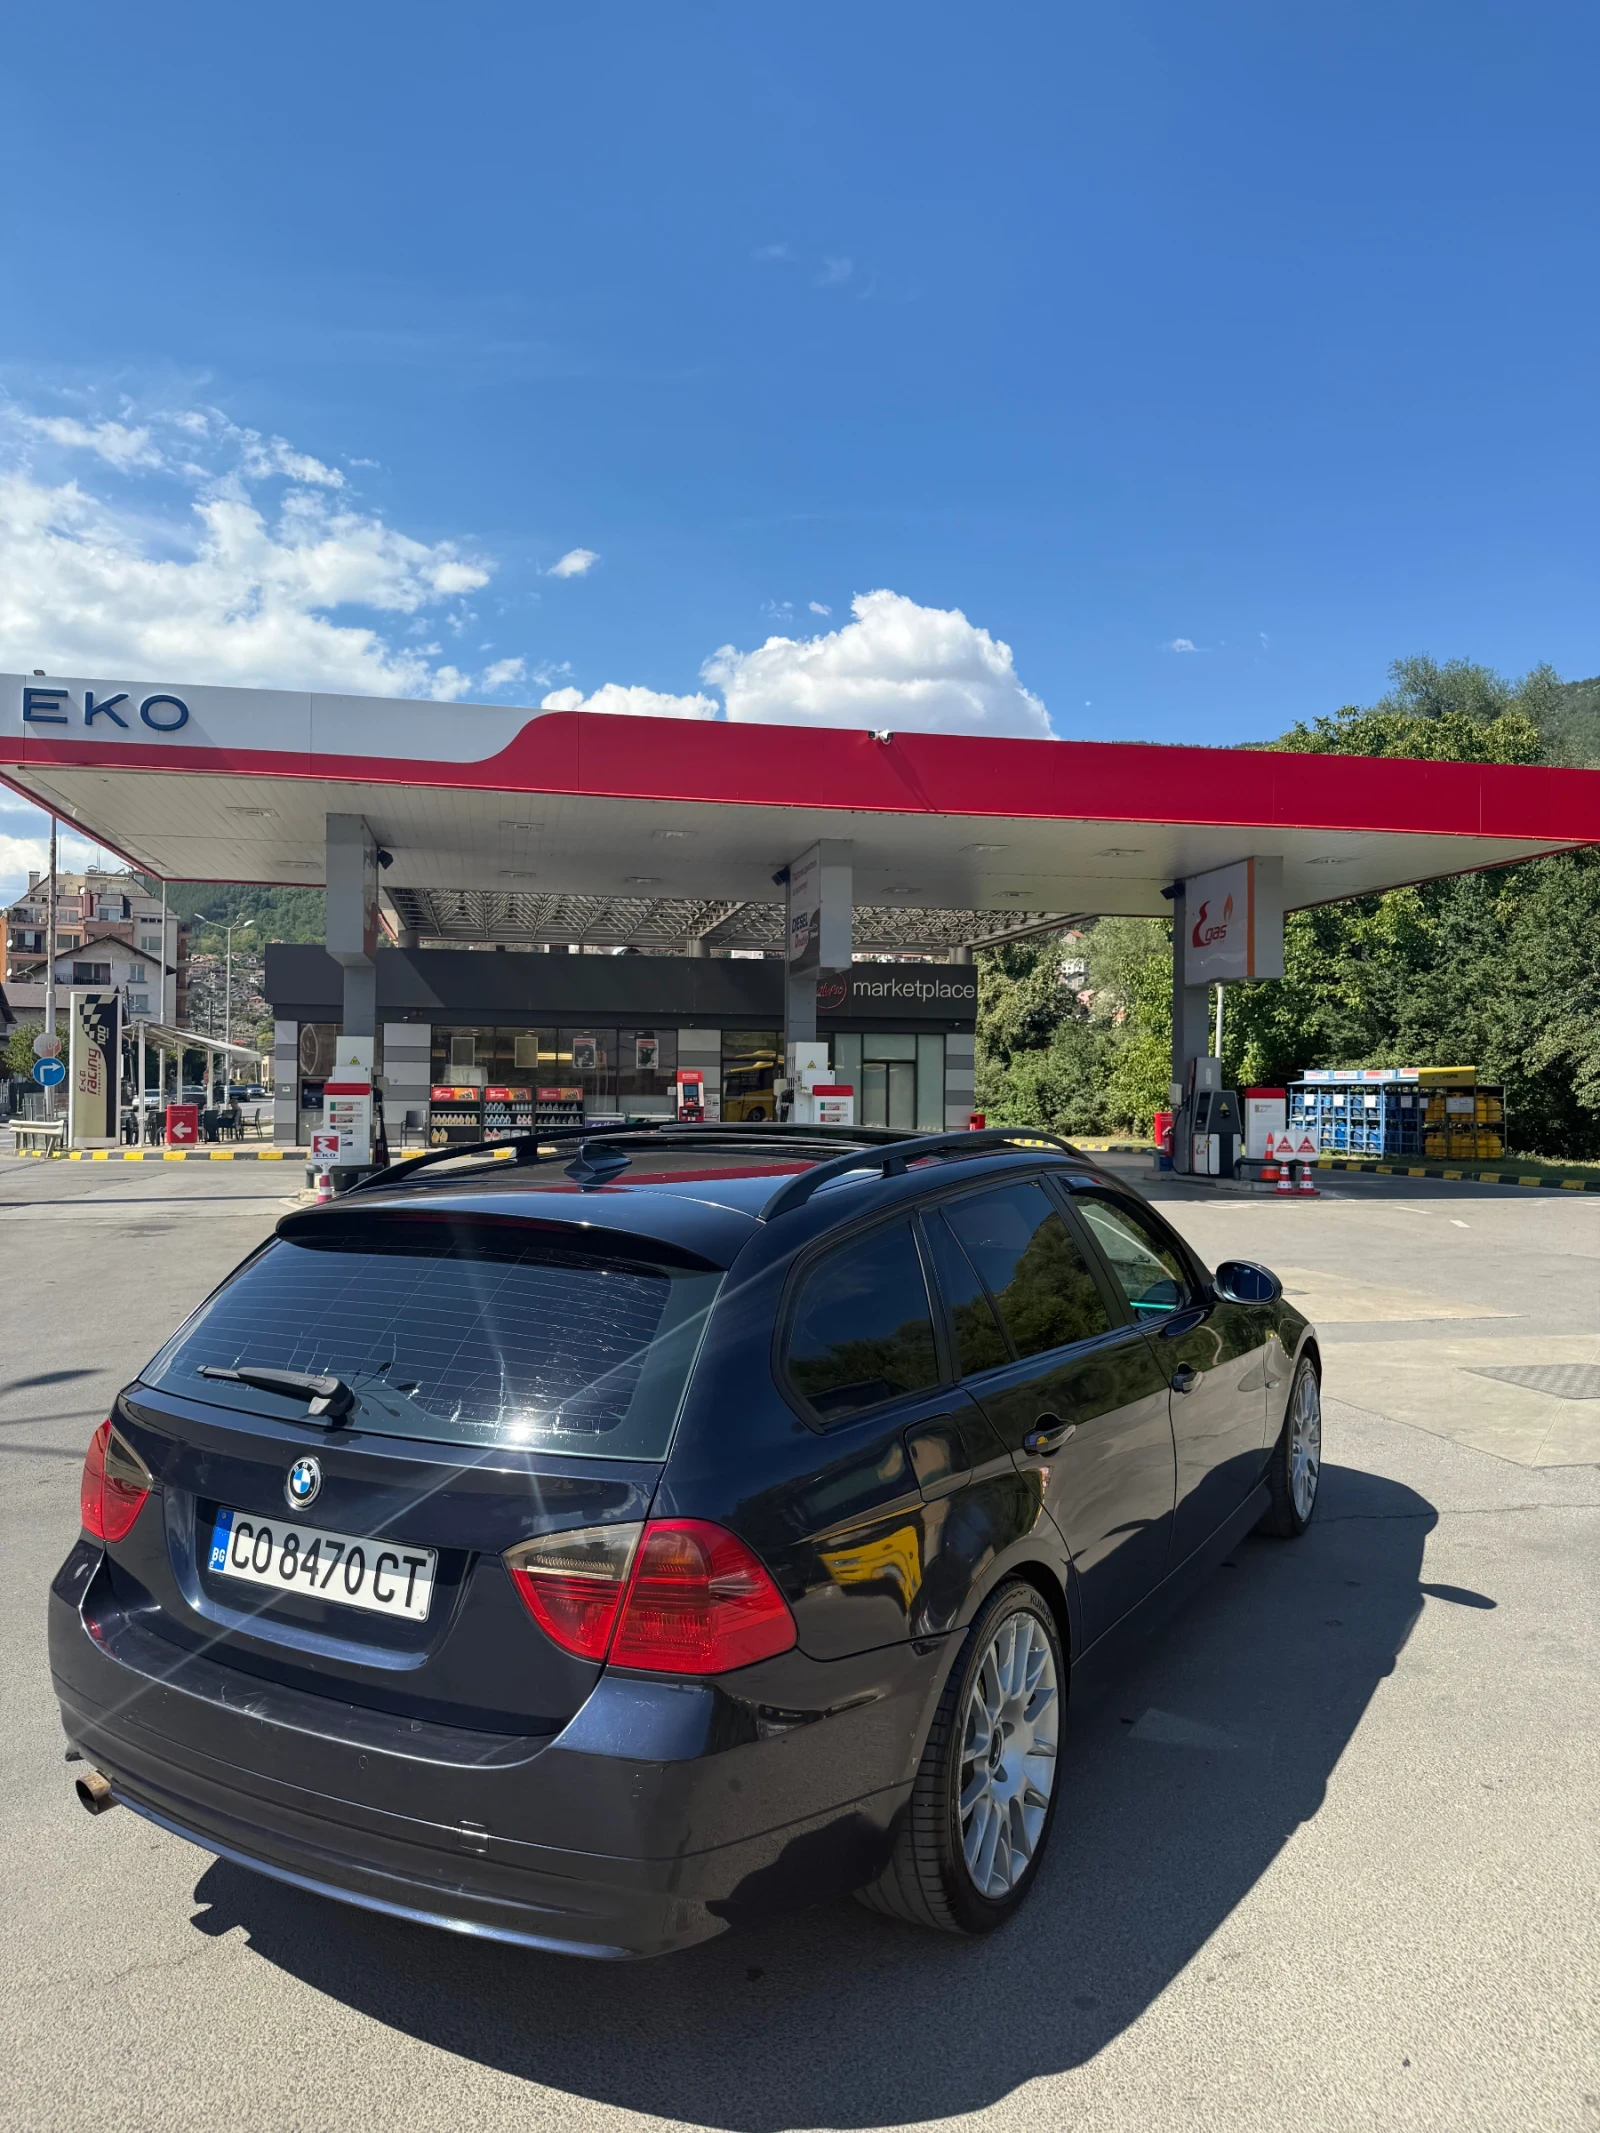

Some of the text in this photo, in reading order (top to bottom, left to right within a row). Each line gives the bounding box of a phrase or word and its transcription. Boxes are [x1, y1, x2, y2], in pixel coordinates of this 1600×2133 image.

[23, 687, 190, 732] EKO
[816, 978, 976, 1003] alypso marketplace
[97, 1025, 106, 1045] 100
[79, 1069, 87, 1093] EKO
[87, 1047, 102, 1096] racing
[293, 1462, 316, 1477] BMW
[211, 1546, 226, 1564] BG
[231, 1521, 428, 1608] CO 8470 CT
[1030, 1593, 1052, 1627] KUMHO
